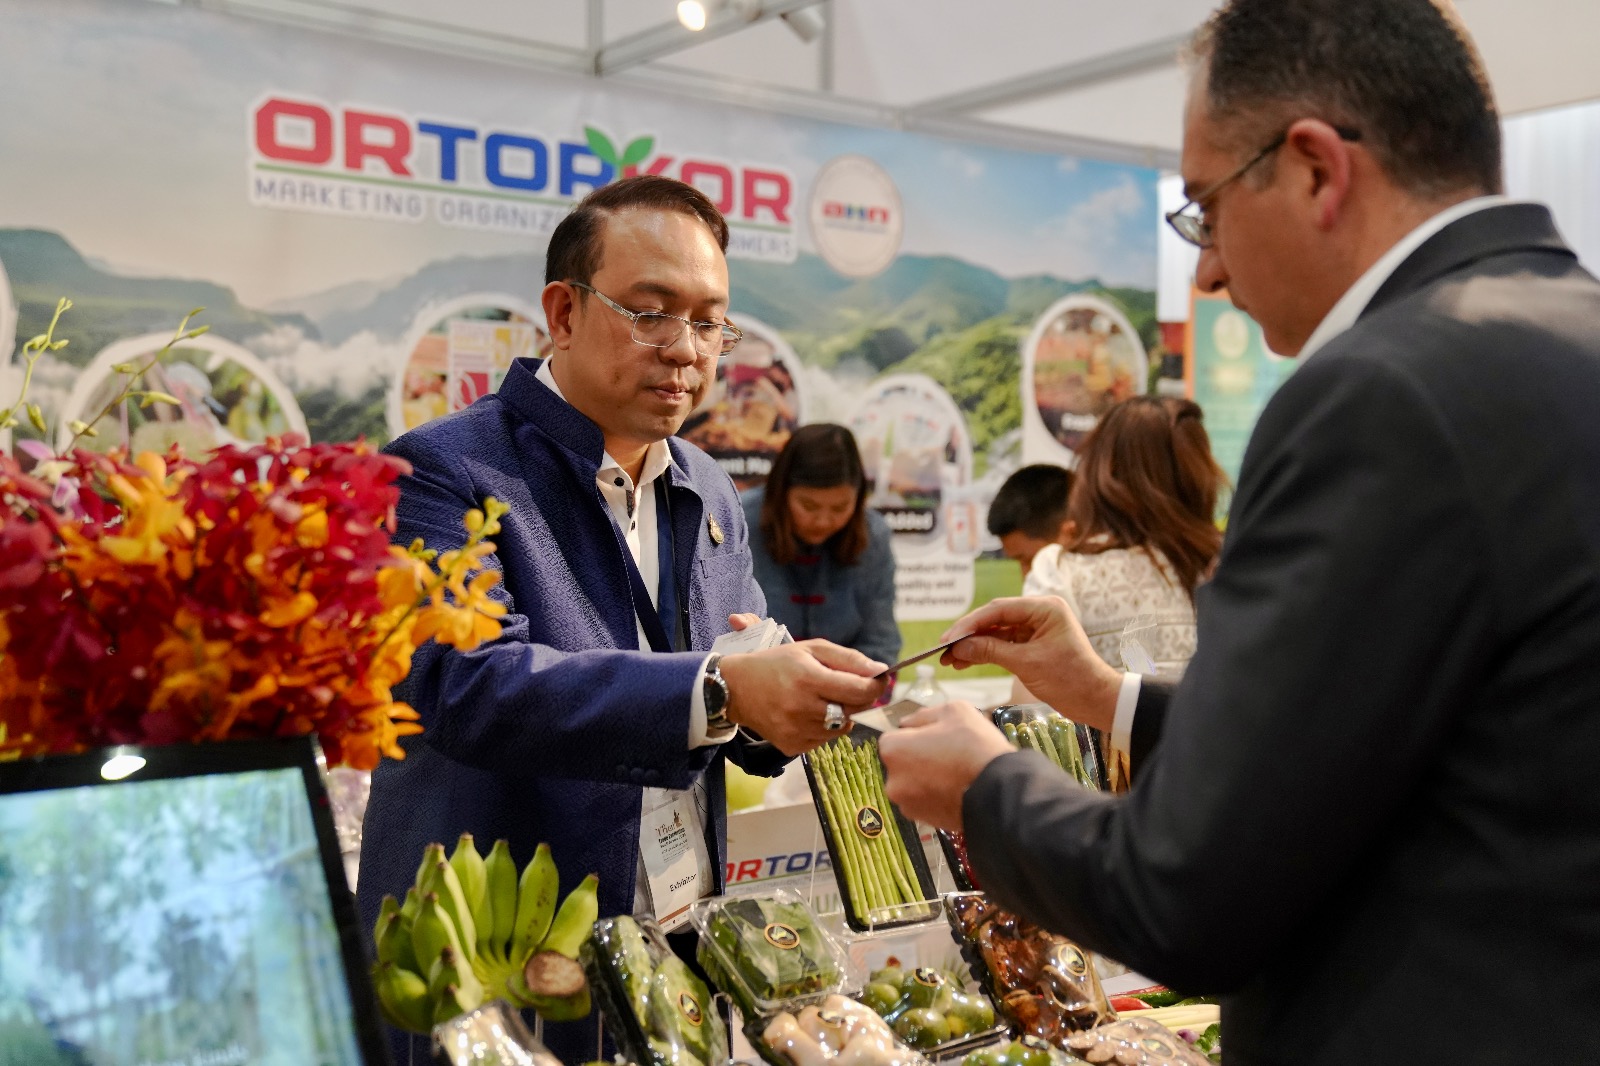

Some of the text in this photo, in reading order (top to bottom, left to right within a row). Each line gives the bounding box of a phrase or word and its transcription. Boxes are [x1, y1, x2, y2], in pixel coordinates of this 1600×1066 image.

[255, 177, 423, 218] MARKETING
[439, 198, 560, 233] ORGANIZ
[670, 873, 697, 892] Exhibitor
